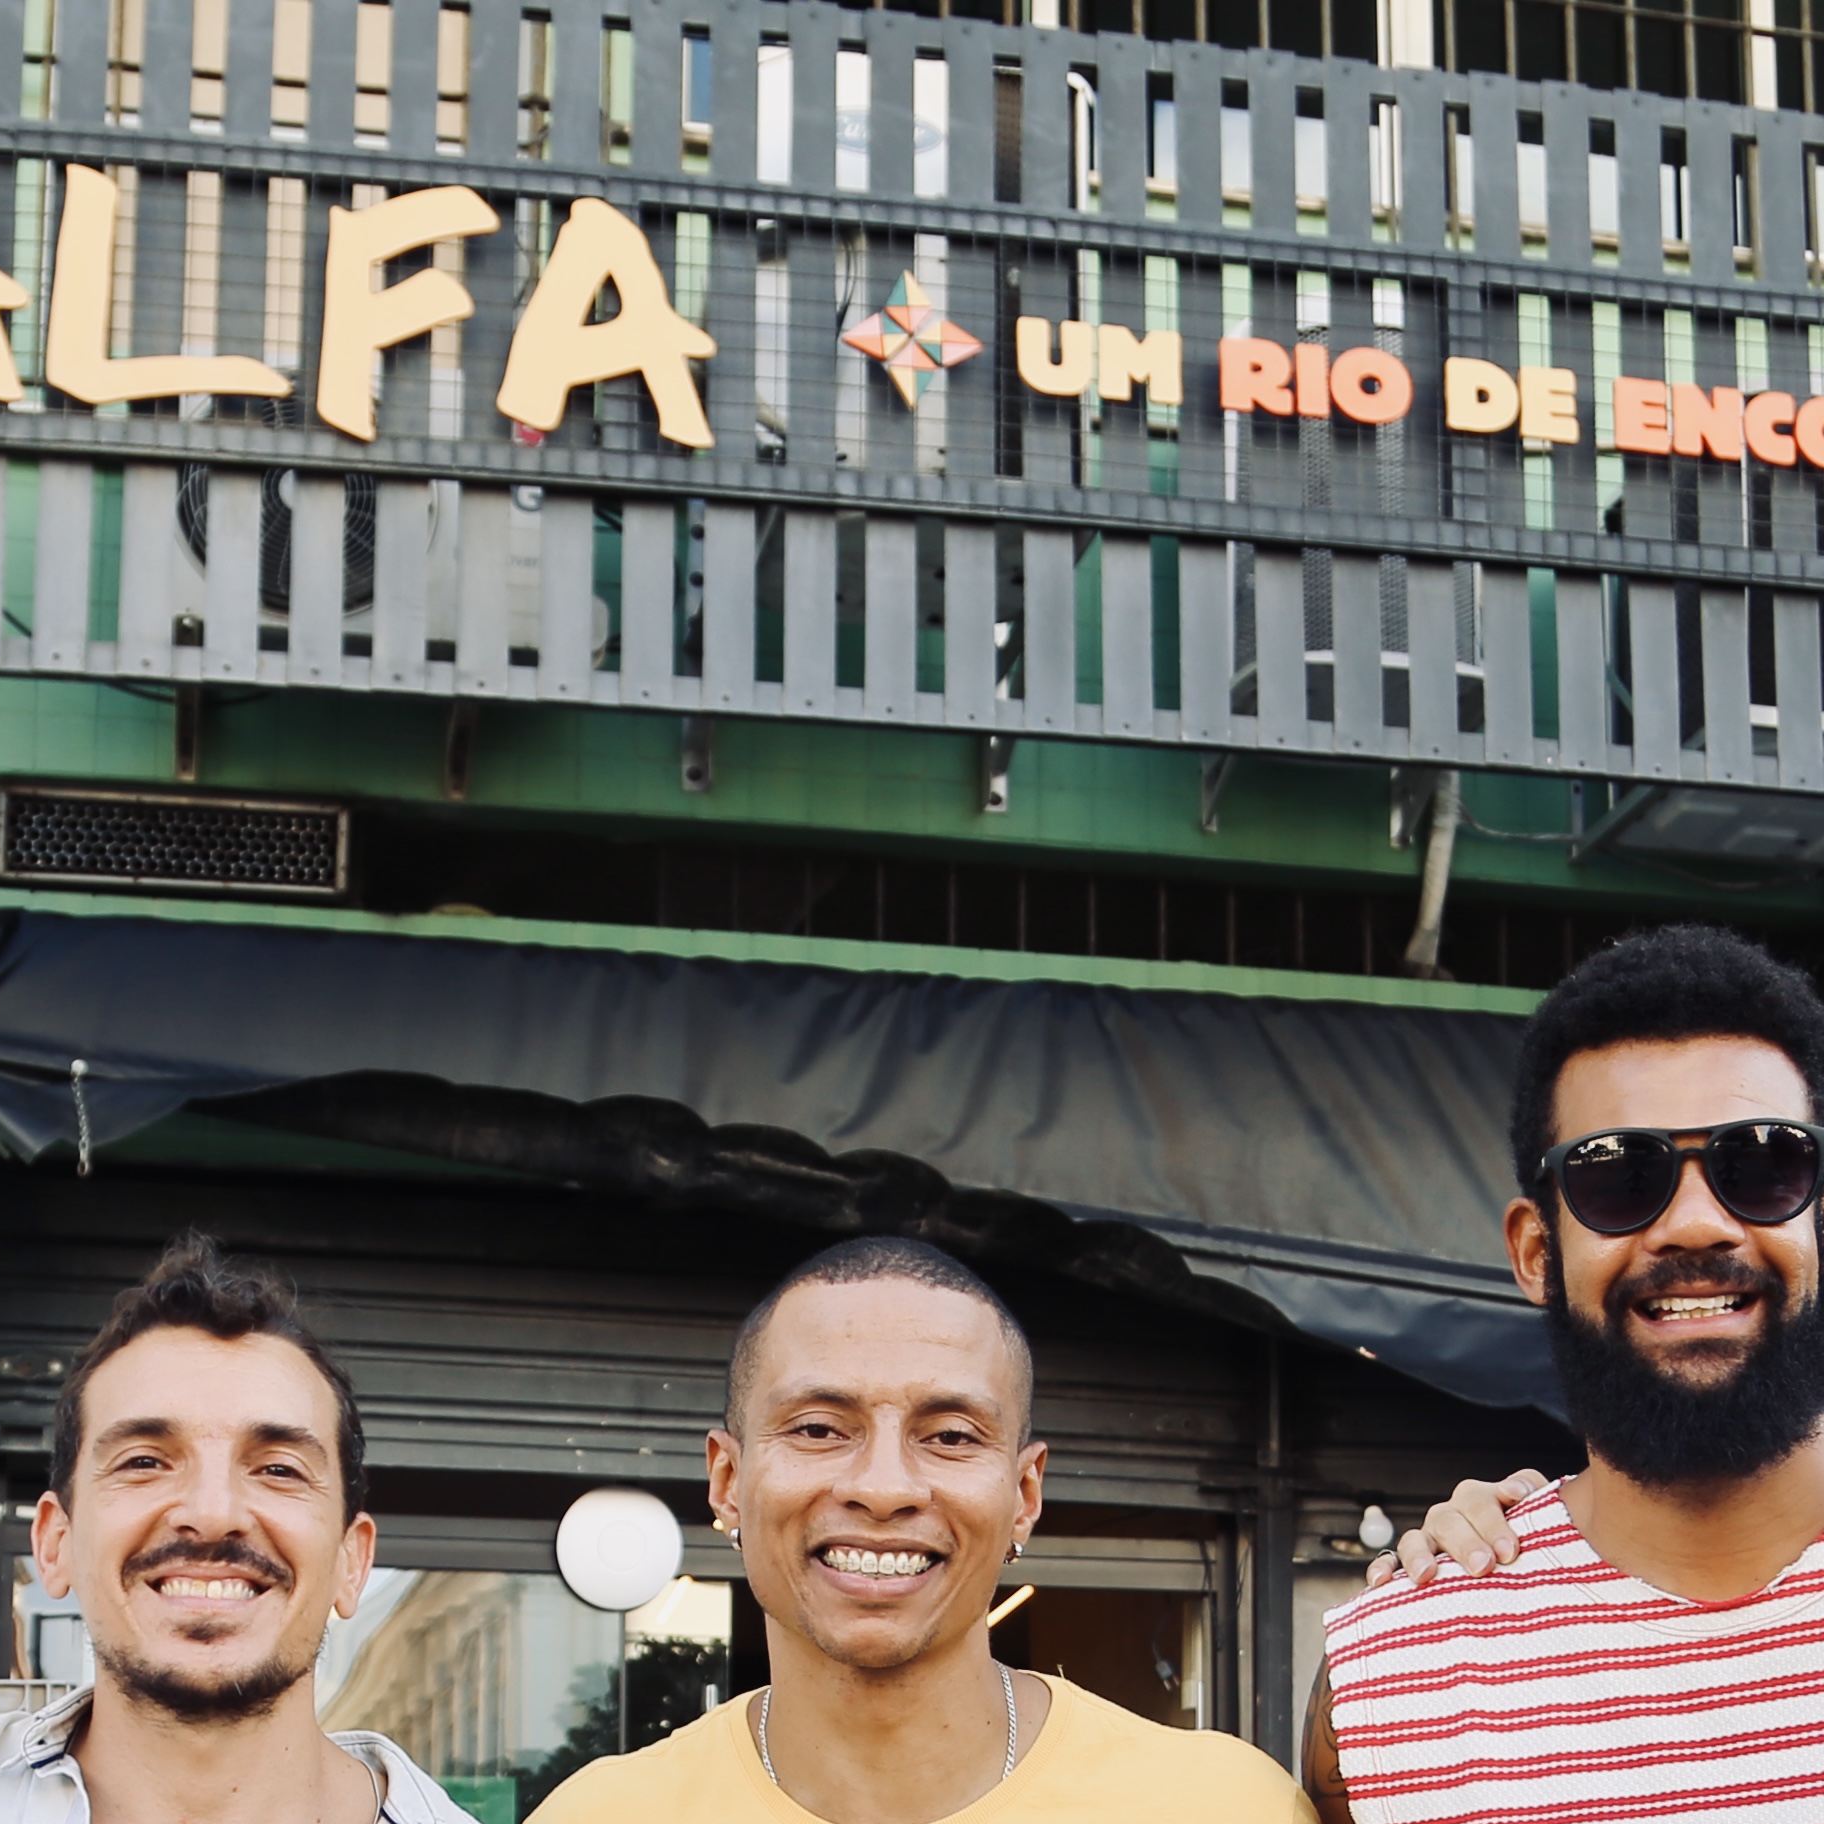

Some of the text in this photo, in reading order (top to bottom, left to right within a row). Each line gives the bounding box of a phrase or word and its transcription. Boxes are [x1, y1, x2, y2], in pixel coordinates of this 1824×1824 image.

[1016, 316, 1182, 404] UM
[1218, 337, 1413, 424] RIO
[1444, 356, 1580, 443] DE
